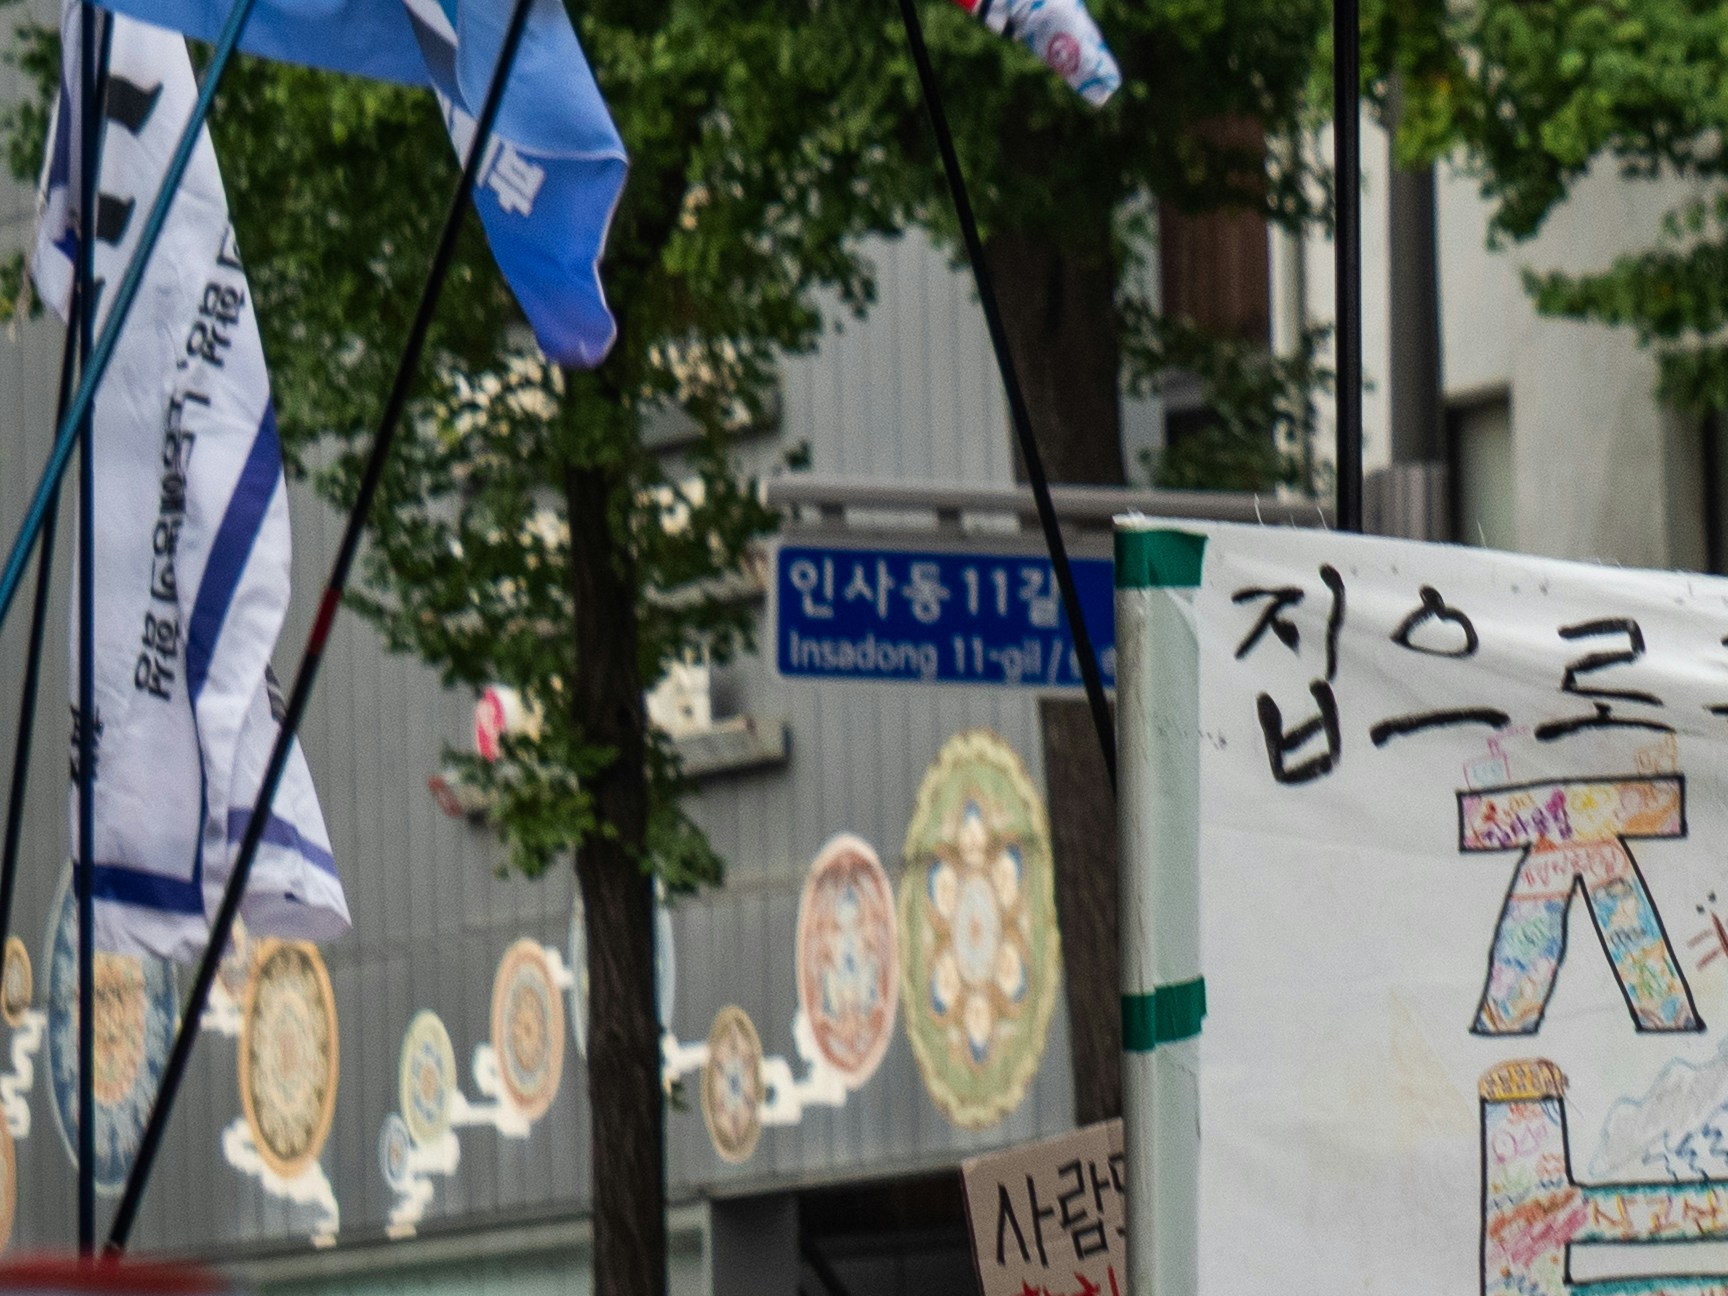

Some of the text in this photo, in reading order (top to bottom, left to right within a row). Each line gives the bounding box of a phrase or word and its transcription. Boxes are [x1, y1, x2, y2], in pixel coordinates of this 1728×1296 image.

[789, 557, 1060, 628] 인사동11길
[789, 630, 938, 682] Insadong
[953, 635, 1043, 684] 11-gil
[1230, 562, 1678, 785] 집으로
[995, 1153, 1127, 1269] 사람
